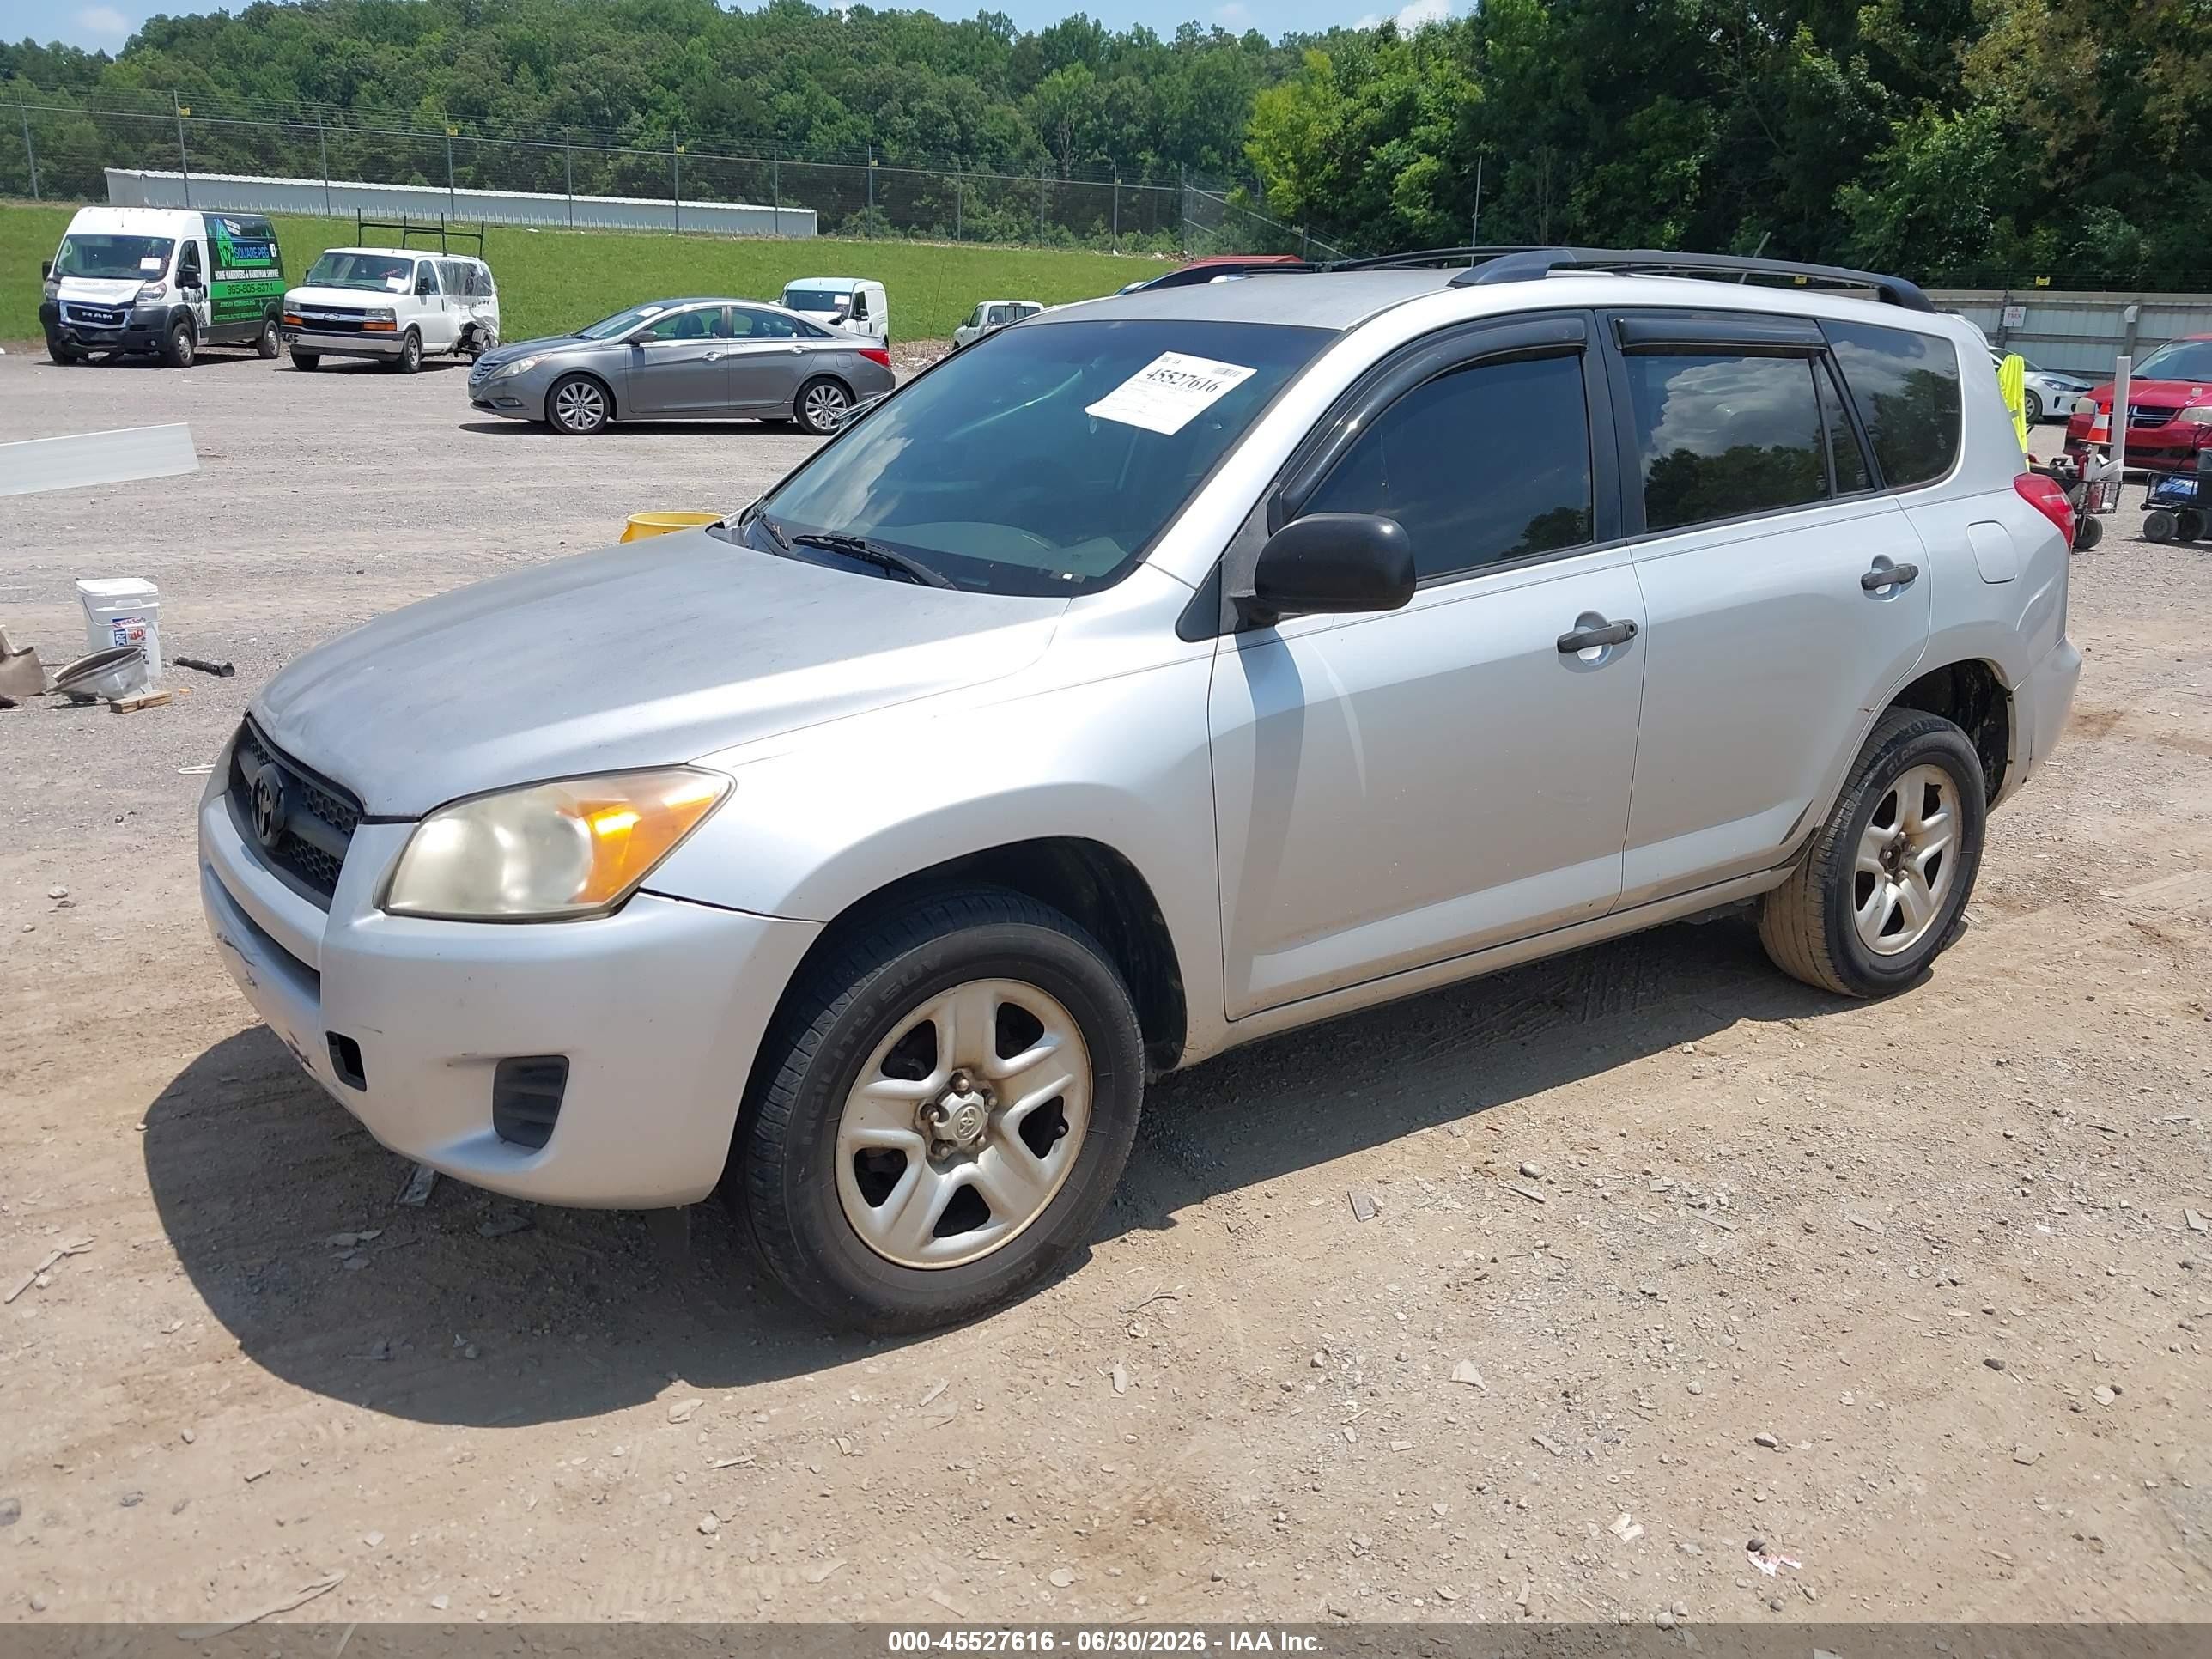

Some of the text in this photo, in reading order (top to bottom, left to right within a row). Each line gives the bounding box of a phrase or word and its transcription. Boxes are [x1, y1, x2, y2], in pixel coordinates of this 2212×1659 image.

[234, 246, 270, 258] SQUARE PEG
[82, 311, 114, 320] RAM
[1146, 368, 1224, 392] 45527616
